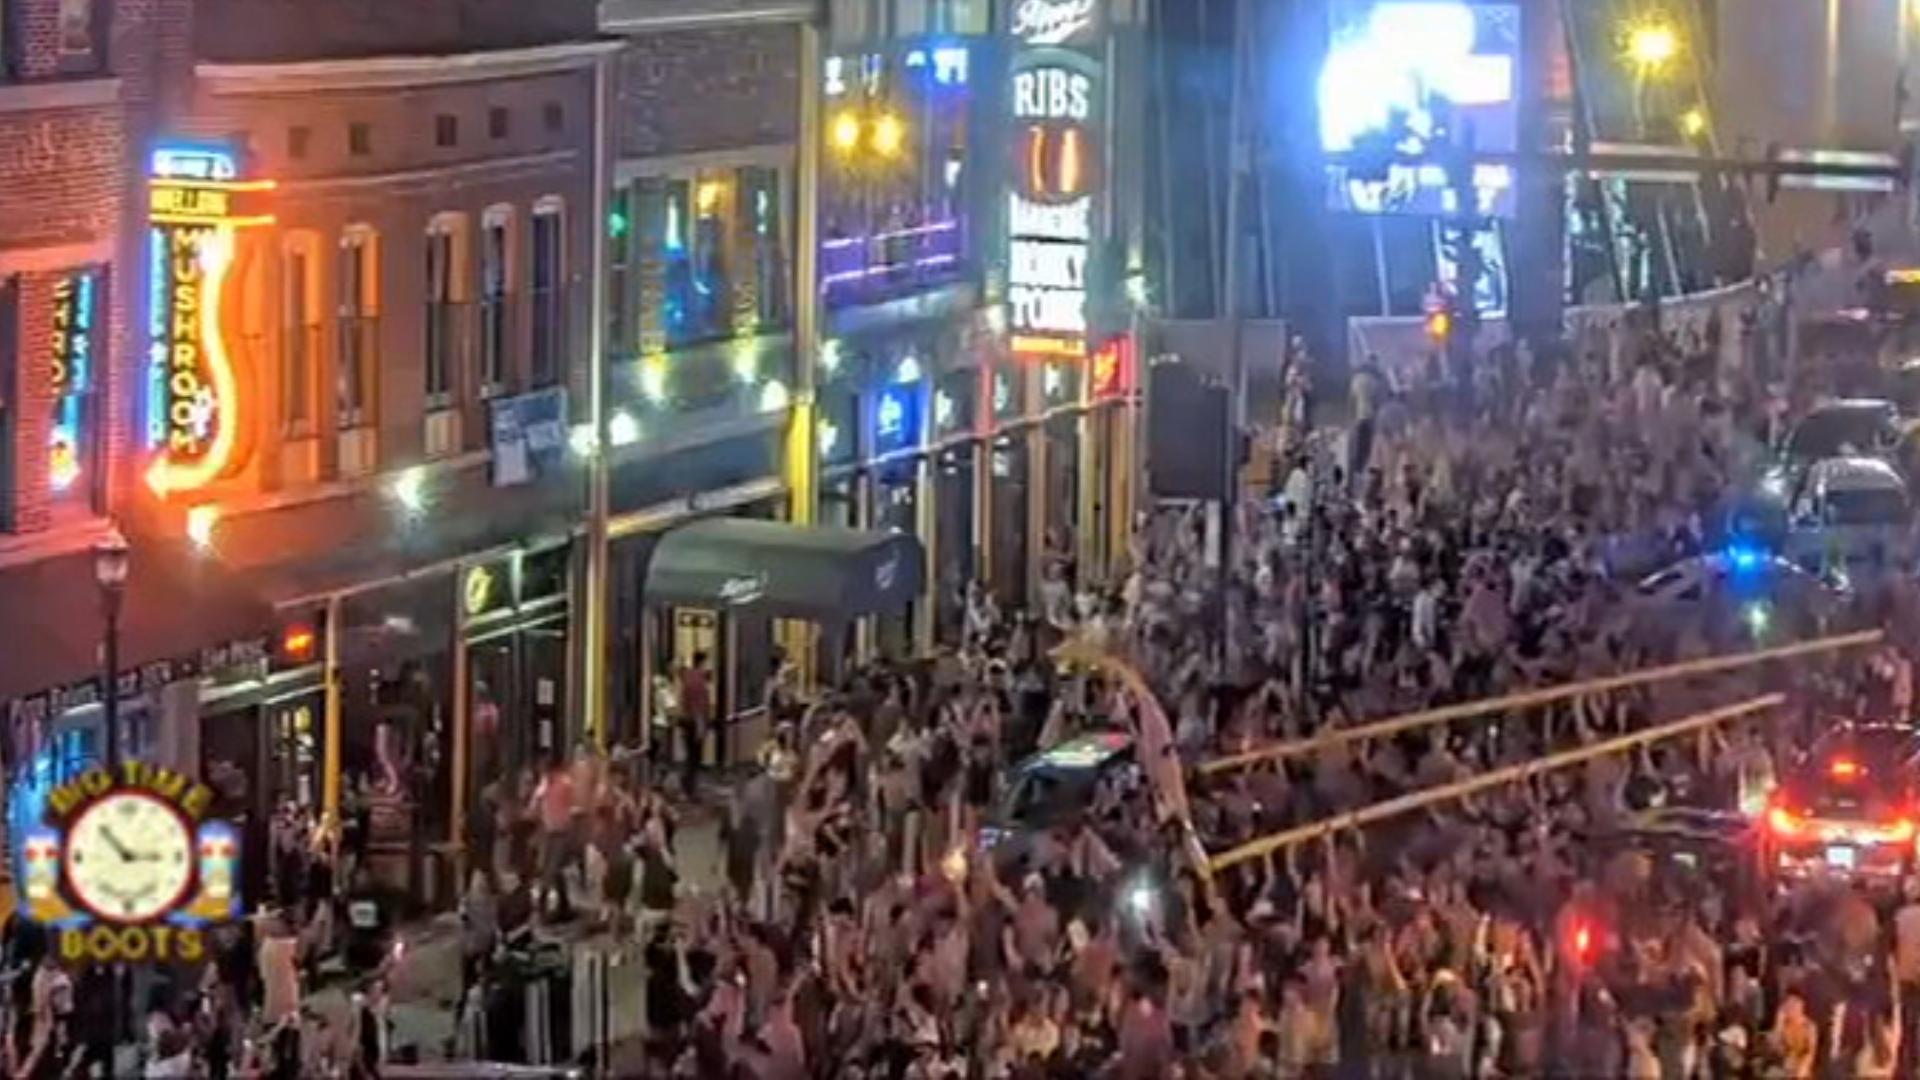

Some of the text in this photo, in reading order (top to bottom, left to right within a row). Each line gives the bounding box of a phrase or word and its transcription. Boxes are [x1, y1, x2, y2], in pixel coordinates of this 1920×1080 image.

[1014, 68, 1089, 119] RIBS
[171, 228, 201, 454] MUSHROOM
[122, 760, 212, 818] TIME
[61, 926, 203, 960] BOOTS
